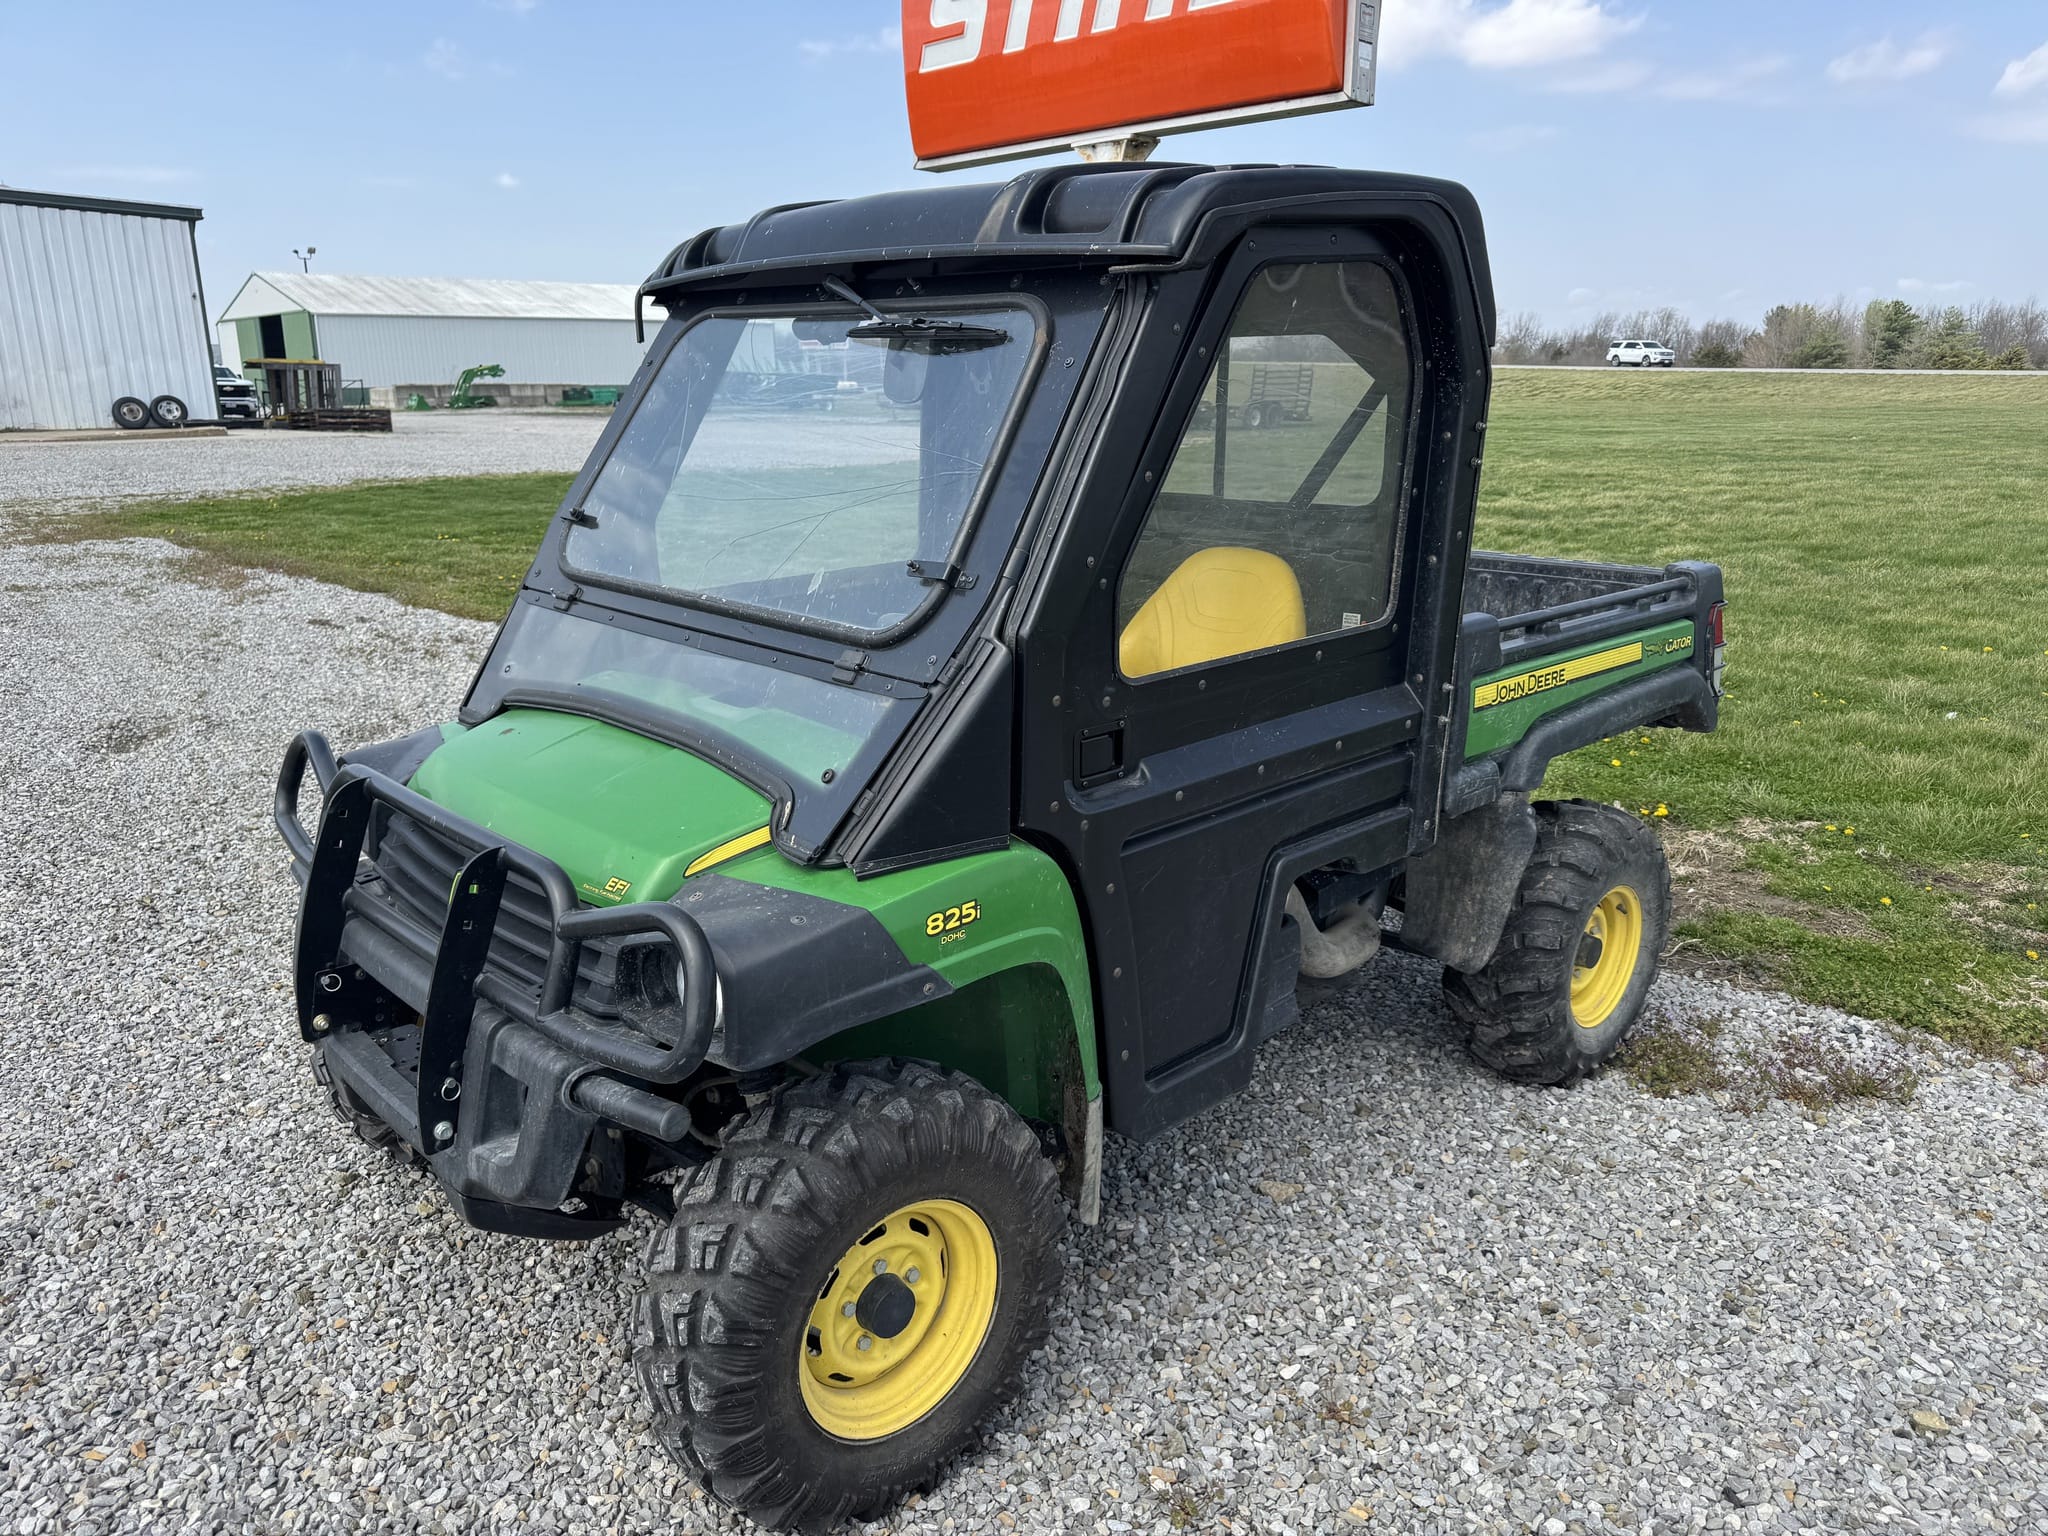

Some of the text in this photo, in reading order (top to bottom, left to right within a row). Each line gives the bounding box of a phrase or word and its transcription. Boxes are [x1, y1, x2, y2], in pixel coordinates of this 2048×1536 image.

[1665, 635, 1692, 652] GATOR
[1491, 668, 1566, 703] JOHN DEERE
[604, 876, 631, 896] EFI
[926, 900, 981, 936] 825i
[941, 929, 966, 945] DOHC
